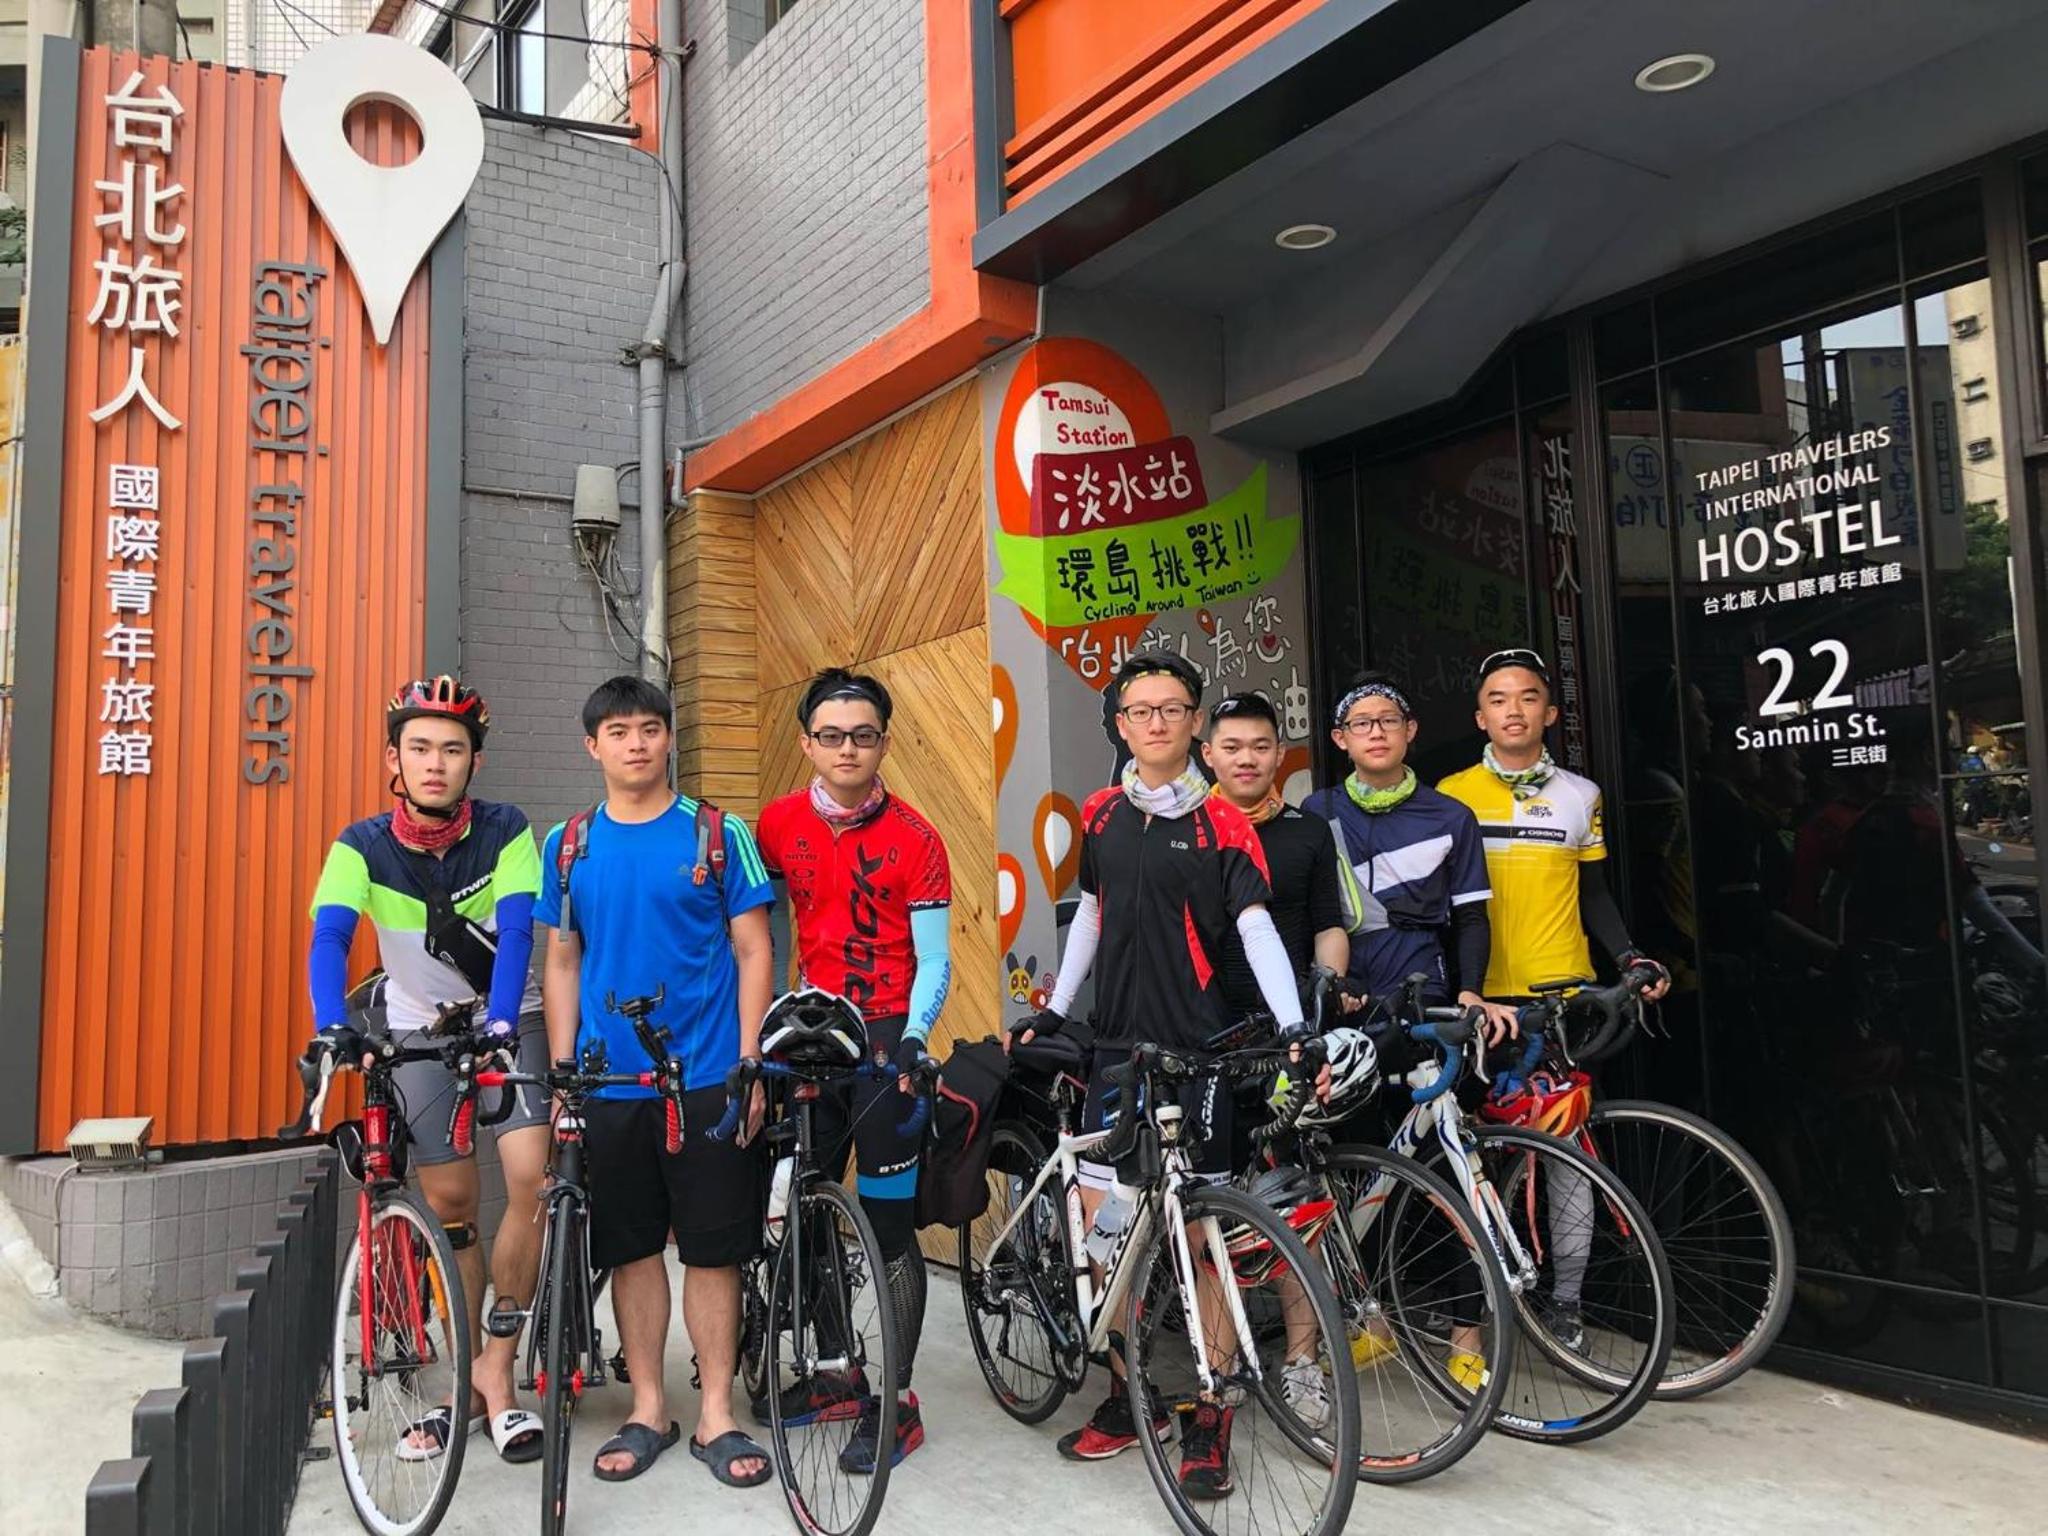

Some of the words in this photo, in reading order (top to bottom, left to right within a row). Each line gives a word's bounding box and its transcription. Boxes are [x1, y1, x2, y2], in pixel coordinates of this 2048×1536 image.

[88, 71, 187, 431] 台北旅人
[241, 258, 330, 456] taipei
[1041, 390, 1111, 417] Tamsui
[1057, 423, 1129, 446] Station
[1051, 451, 1193, 529] 淡水站
[1696, 459, 1760, 491] TAIPEI
[1768, 426, 1892, 475] TRAVELERS
[1706, 463, 1881, 521] INTERNATIONAL
[1698, 500, 1902, 582] HOSTEL
[100, 463, 161, 778] 國際青年旅館
[1083, 602, 1138, 621] Cycling
[1145, 594, 1186, 611] Around
[1196, 580, 1243, 605] Taiwan
[1703, 562, 1903, 615] 台北旅人國際青年旅館
[243, 481, 314, 784] travelers
[1756, 639, 1854, 716] 22
[1736, 719, 1840, 750] Sanmin
[1848, 713, 1886, 738] St.
[1832, 745, 1887, 767] 三民街
